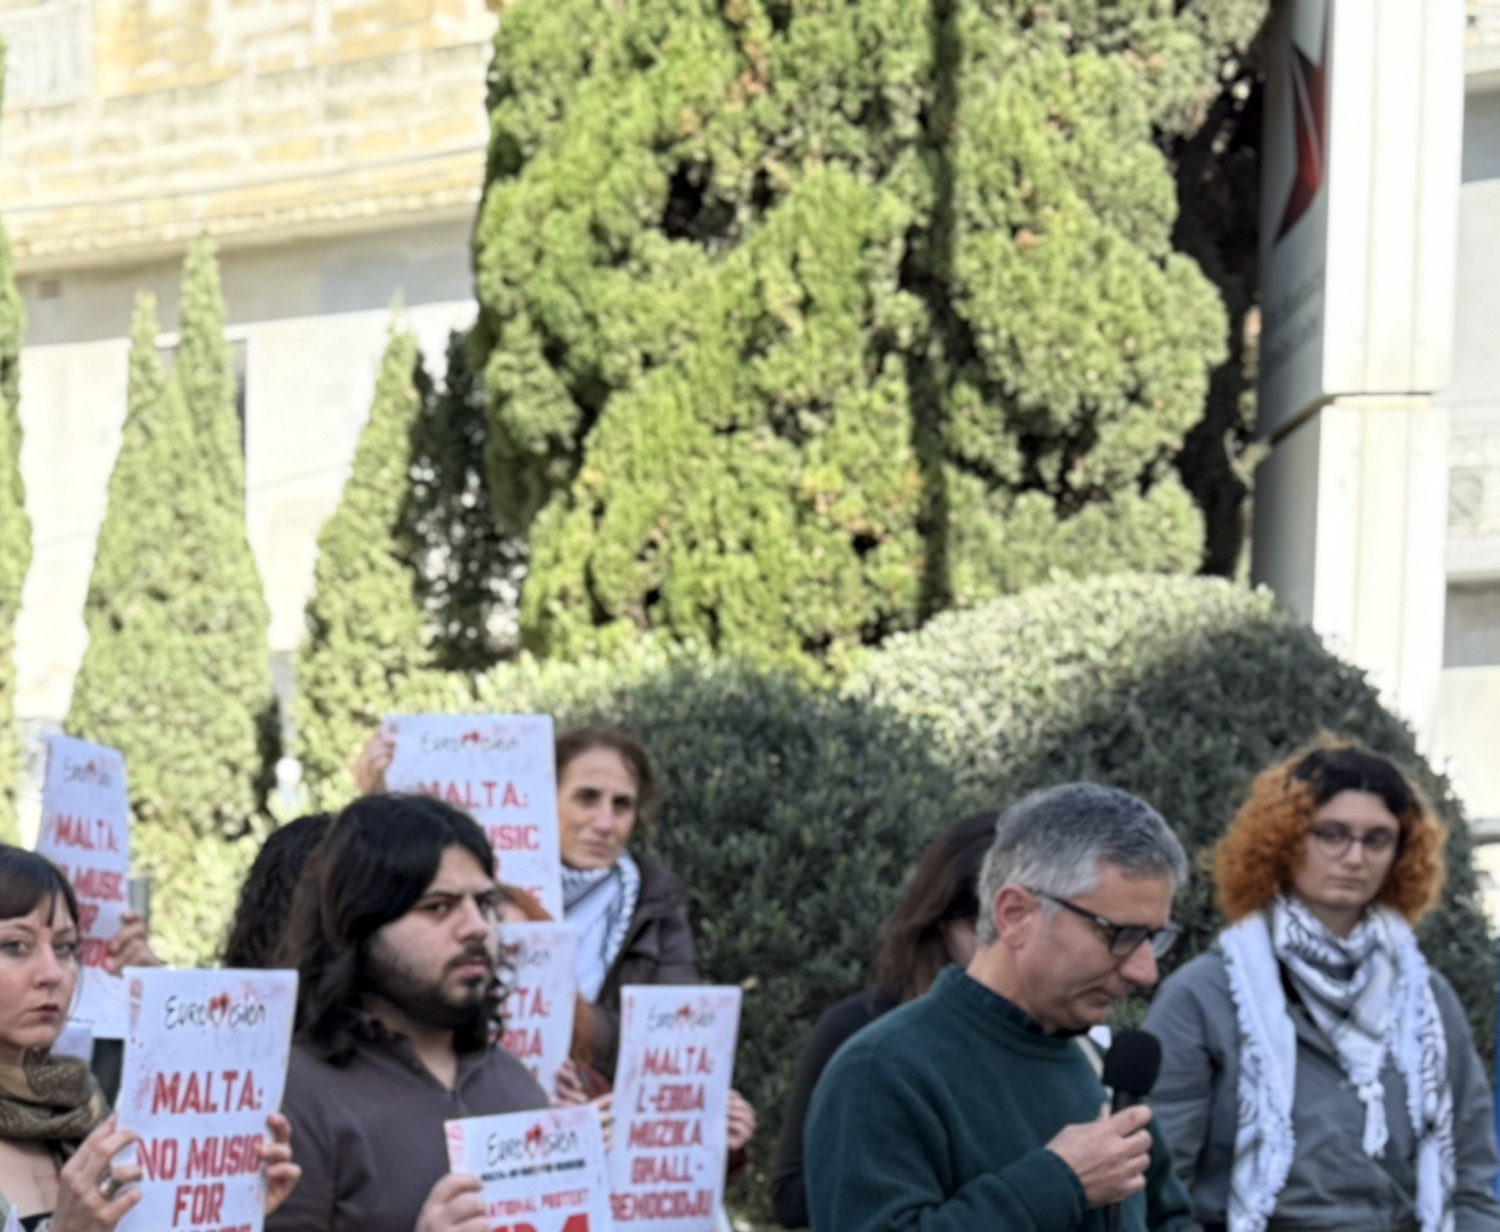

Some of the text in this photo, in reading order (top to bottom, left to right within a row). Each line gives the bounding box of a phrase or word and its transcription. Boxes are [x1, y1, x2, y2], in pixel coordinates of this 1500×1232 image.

[643, 1046, 714, 1075] MALTA:
[151, 1070, 263, 1115] MALTA:
[137, 1134, 264, 1181] NO MUSIC
[172, 1183, 224, 1227] FOR
